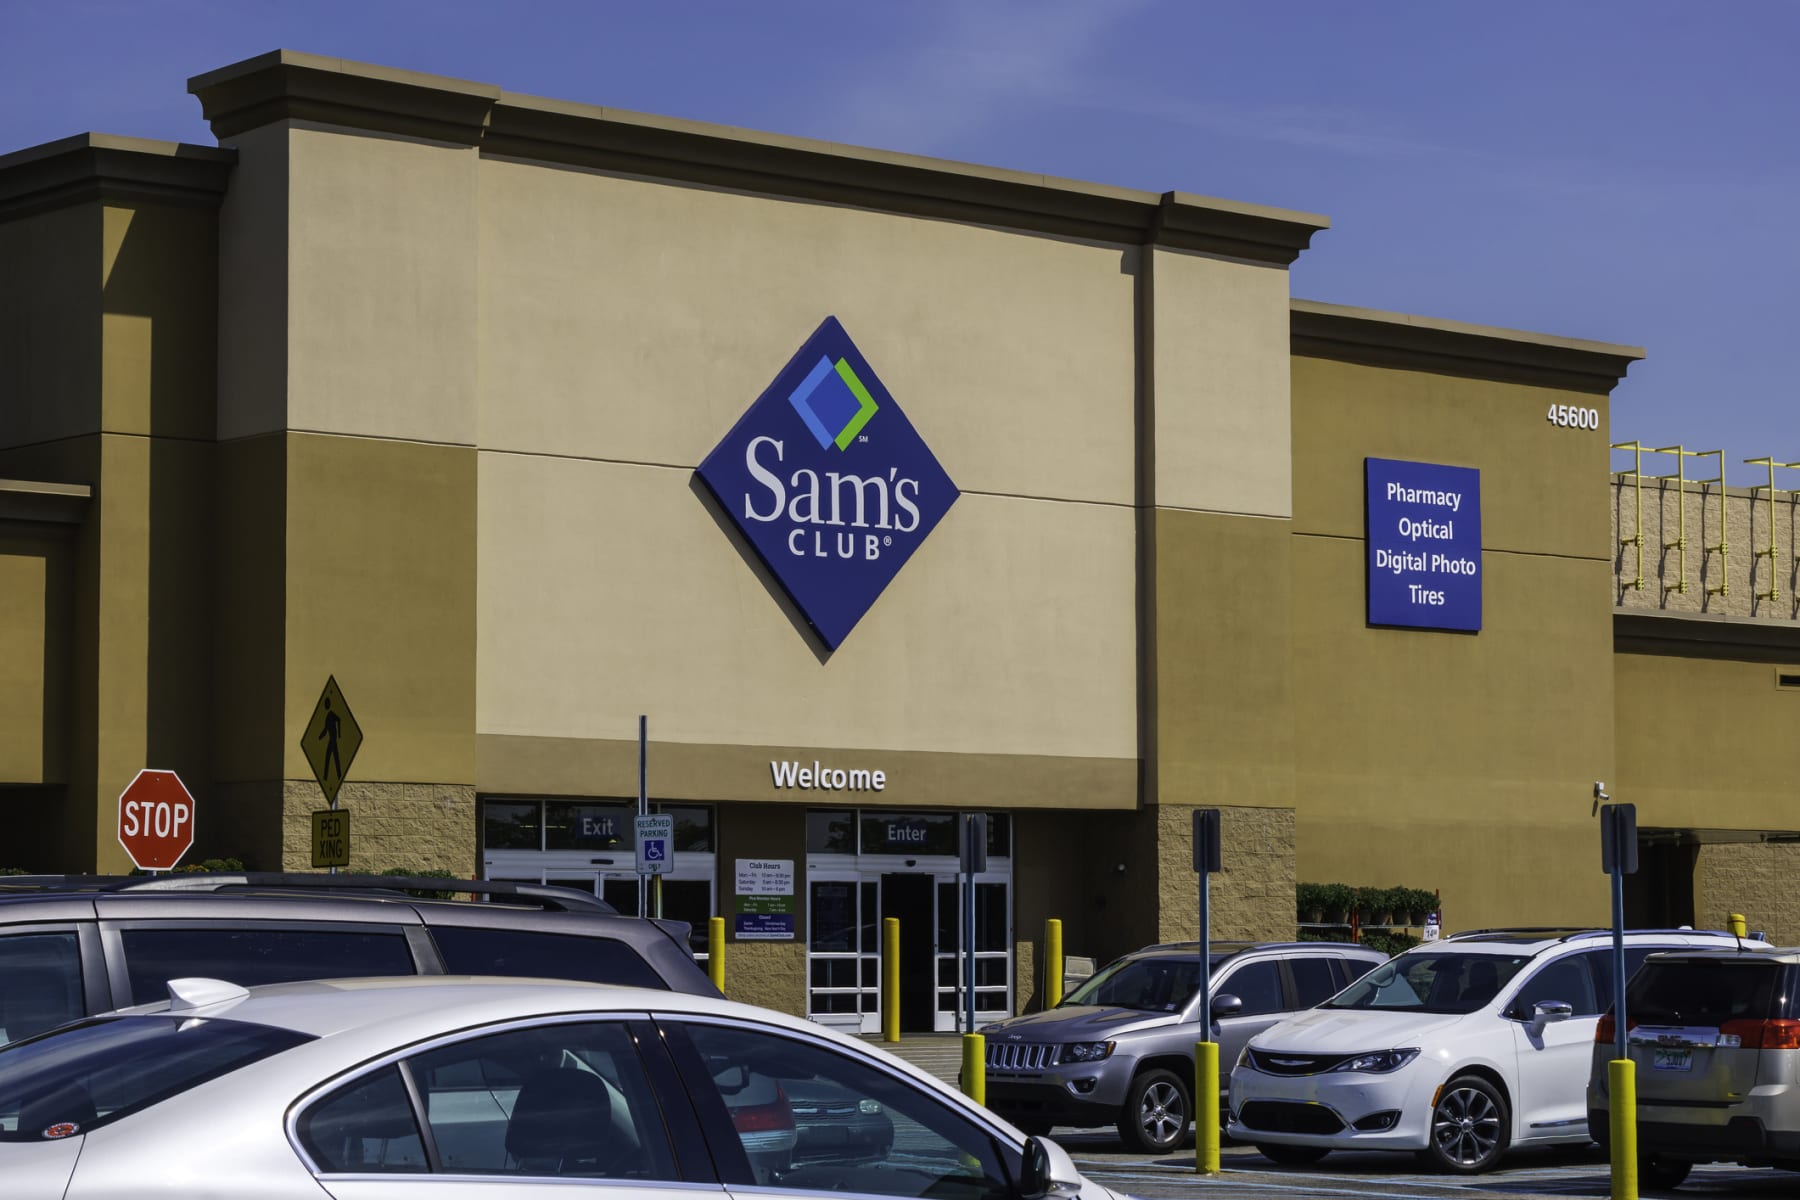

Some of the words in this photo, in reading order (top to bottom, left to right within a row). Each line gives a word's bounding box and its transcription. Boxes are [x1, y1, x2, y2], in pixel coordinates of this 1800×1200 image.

[1548, 404, 1599, 430] 45600
[744, 435, 920, 533] Sam's
[1387, 482, 1462, 511] Pharmacy
[1398, 517, 1453, 541] Optical
[1376, 549, 1427, 575] Digital
[1431, 554, 1477, 576] Photo
[1408, 584, 1445, 606] Tires
[771, 760, 887, 791] Welcome
[123, 800, 189, 839] STOP
[320, 818, 341, 839] PED
[583, 817, 614, 836] Exit
[637, 819, 671, 829] RESERVED
[640, 829, 668, 838] PARKING
[887, 824, 927, 842] Enter
[319, 840, 343, 860] XING
